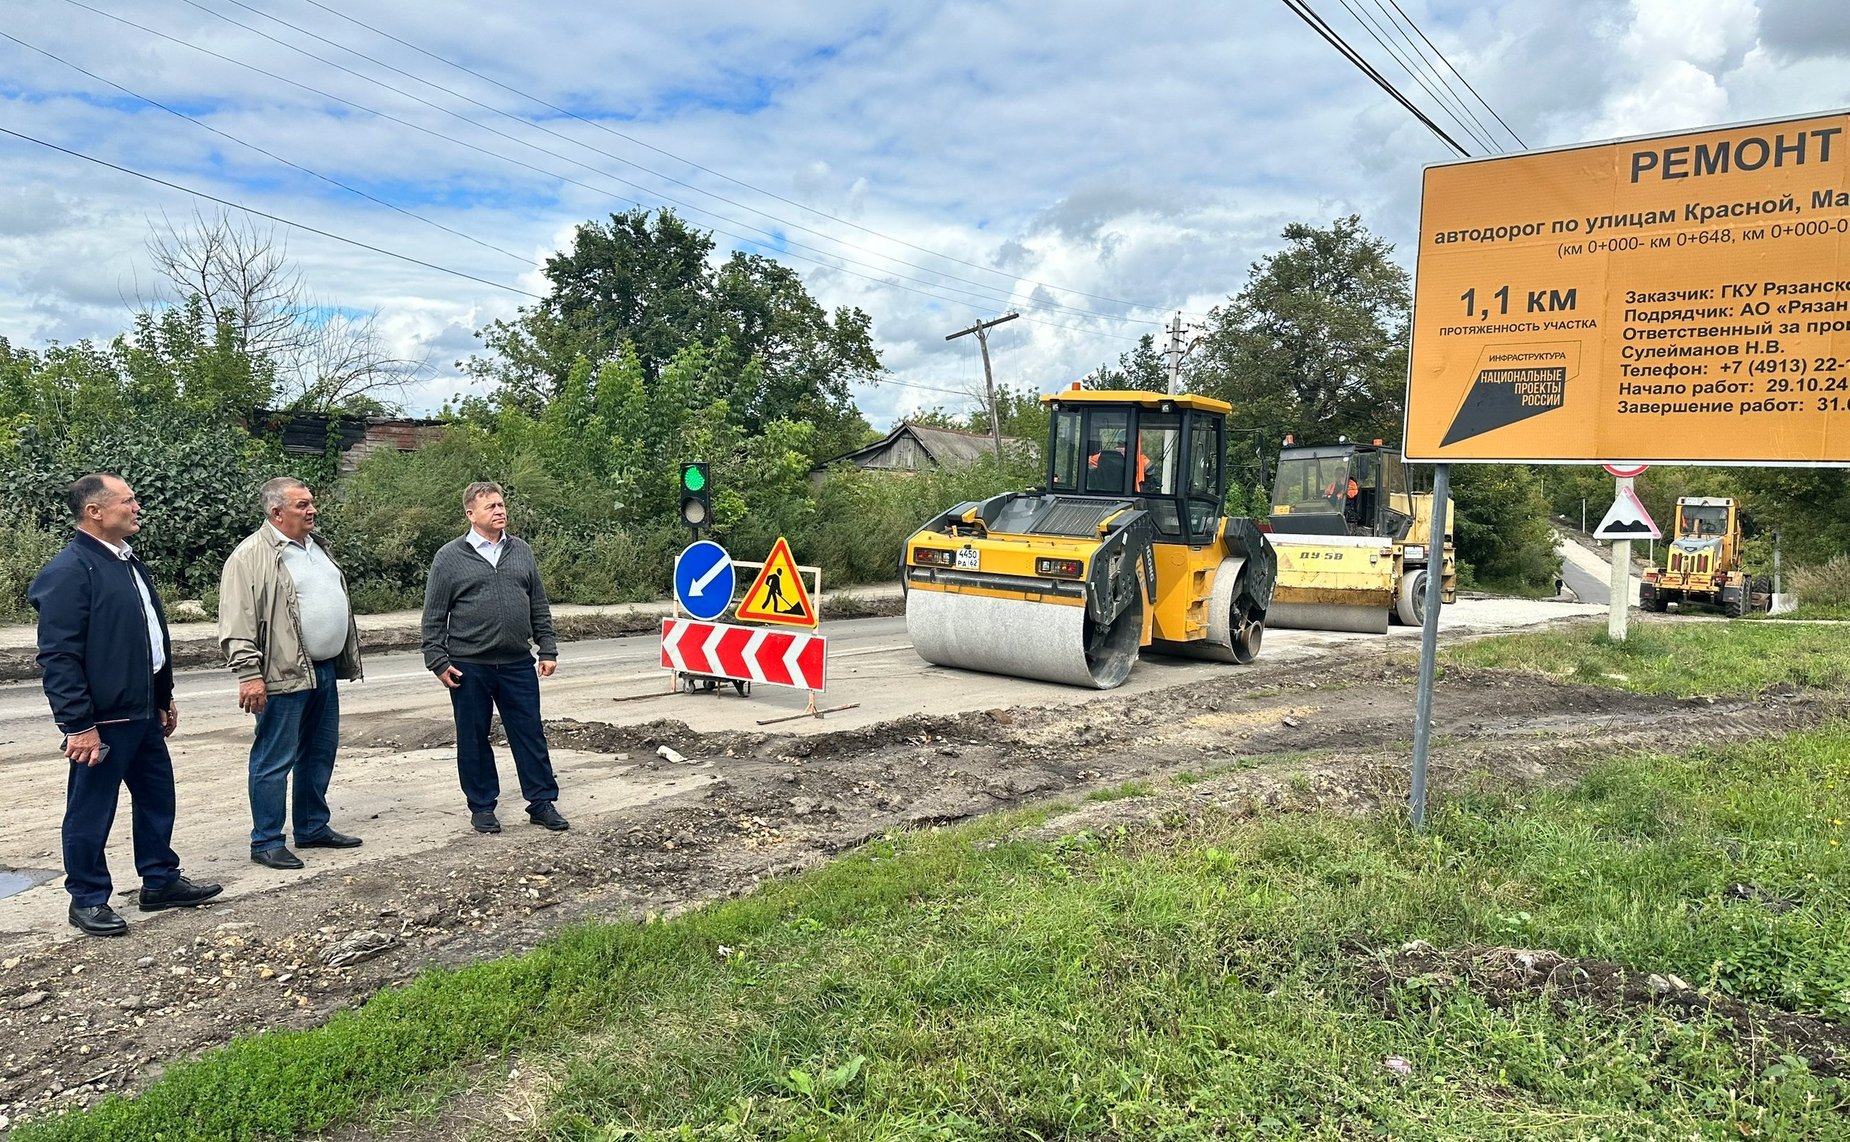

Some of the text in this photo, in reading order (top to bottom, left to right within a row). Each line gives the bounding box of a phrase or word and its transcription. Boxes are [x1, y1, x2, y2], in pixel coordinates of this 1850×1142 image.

[1630, 127, 1842, 183] РЕМОНТ
[1434, 222, 1545, 245] автодорог
[1551, 218, 1579, 234] по
[1585, 209, 1676, 235] улицам
[1684, 193, 1801, 224] Красной,
[1557, 218, 1849, 259] (км 0+000- км 0+648, км 0+000-0
[1460, 285, 1577, 321] 1,1 км
[1625, 289, 1714, 304] Заказчик:
[1721, 283, 1758, 298] ГКУ
[1624, 300, 1848, 323] Подрядчик: АО «Рязан
[1439, 319, 1597, 336] ПРОТЯЖЕННОСТЬ УЧАСТКА
[1622, 320, 1773, 341] Ответственный
[1778, 322, 1800, 334] за
[1489, 352, 1566, 362] ИНФРАСТРУКТУРА
[1621, 340, 1785, 361] Сулейманов Н.В.
[1480, 369, 1562, 384] НАЦИОНАЛЬНЫЕ
[1620, 362, 1708, 379] Телефон:
[1720, 360, 1743, 374] +7
[1748, 358, 1807, 377] (4913)
[1514, 381, 1561, 395] ПРОЕКТЫ
[1619, 376, 1848, 397] Начало работ: 29.10.24
[1521, 394, 1561, 406] РОССИИ
[1617, 400, 1734, 416] Завершение
[1739, 398, 1804, 416] работ:
[958, 550, 978, 559] 4450
